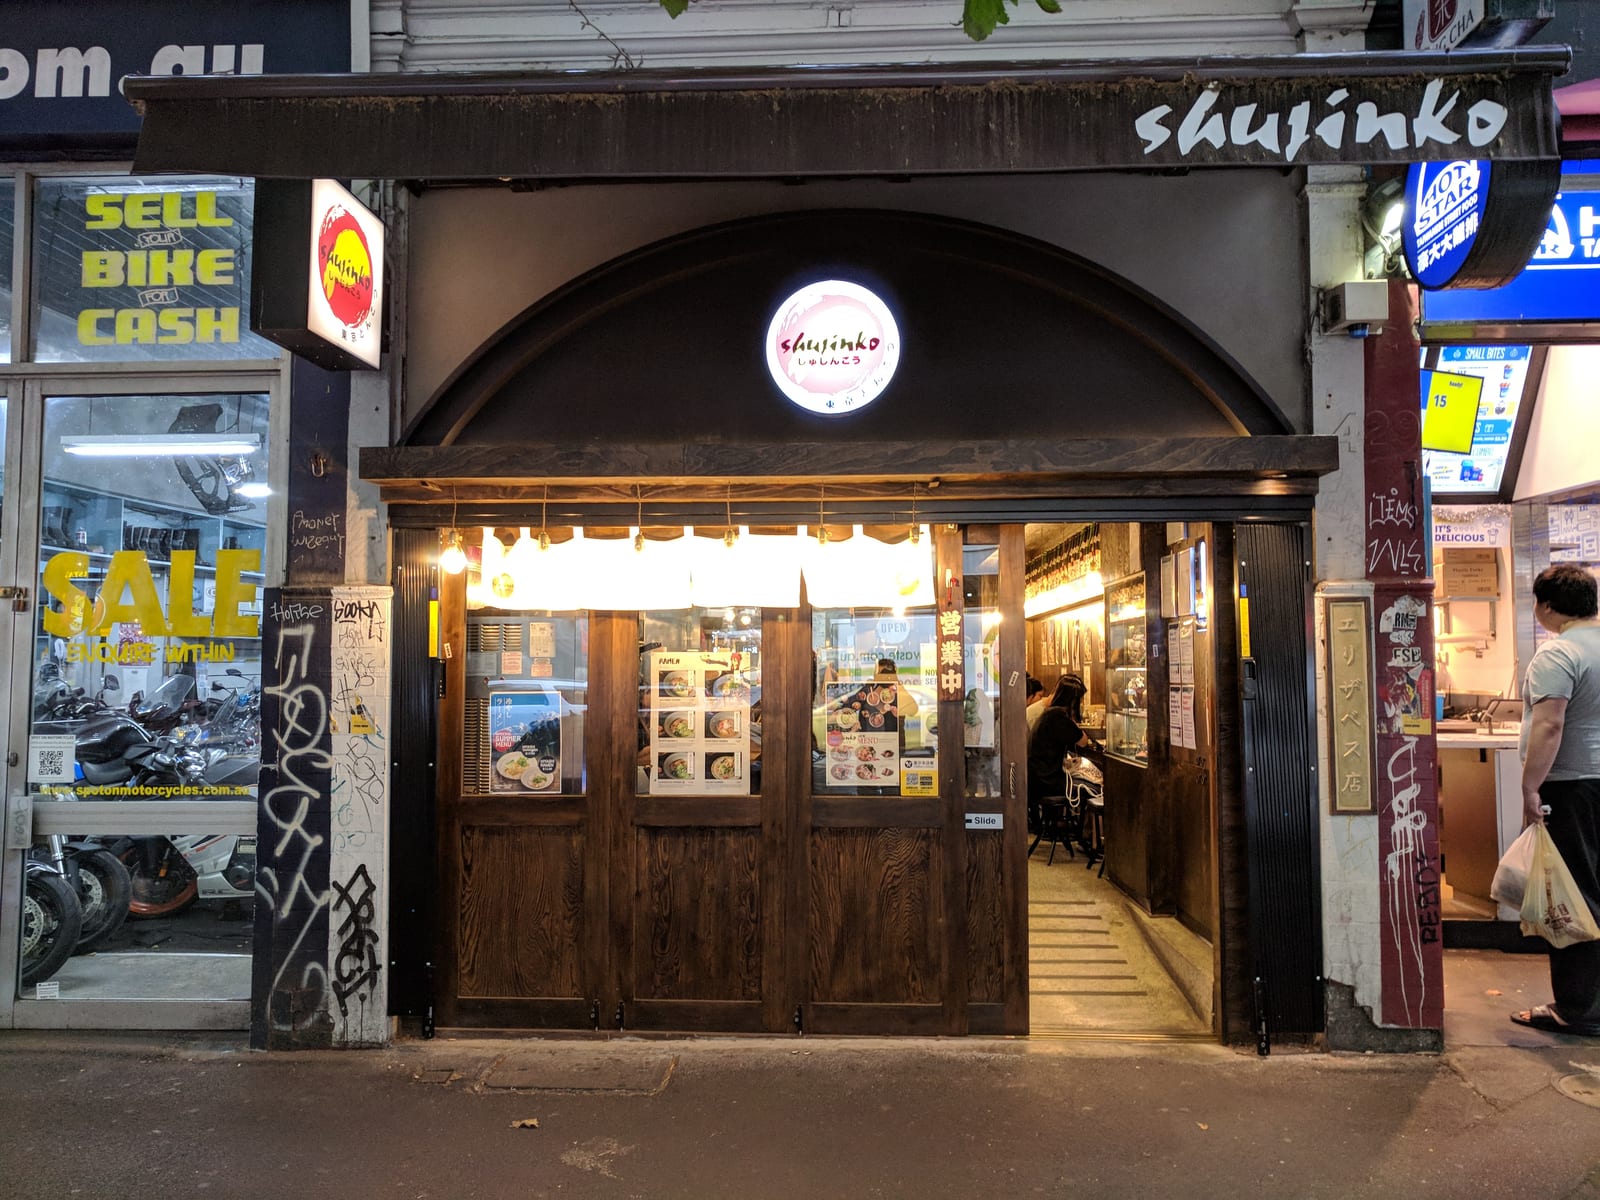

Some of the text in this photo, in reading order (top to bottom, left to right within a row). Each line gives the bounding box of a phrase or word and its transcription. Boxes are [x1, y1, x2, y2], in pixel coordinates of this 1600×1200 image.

[1135, 78, 1508, 161] shujinko
[1419, 176, 1473, 230] STAR
[1425, 165, 1466, 207] HOT
[85, 191, 234, 230] SELL
[81, 248, 235, 288] BIKE
[76, 307, 241, 346] CASH
[781, 331, 881, 355] shujinko
[1464, 347, 1506, 360] SMALL BITES
[1434, 394, 1447, 408] 15
[1434, 525, 1451, 533] IT'S
[1434, 533, 1485, 542] DELICIOUS
[42, 548, 261, 638] SALE
[880, 621, 907, 634] OPEN
[66, 641, 235, 665] ENQUIRE WITHIN
[939, 610, 962, 694] 営業中
[1337, 617, 1363, 793] エリザベス店
[974, 816, 996, 825] Slide
